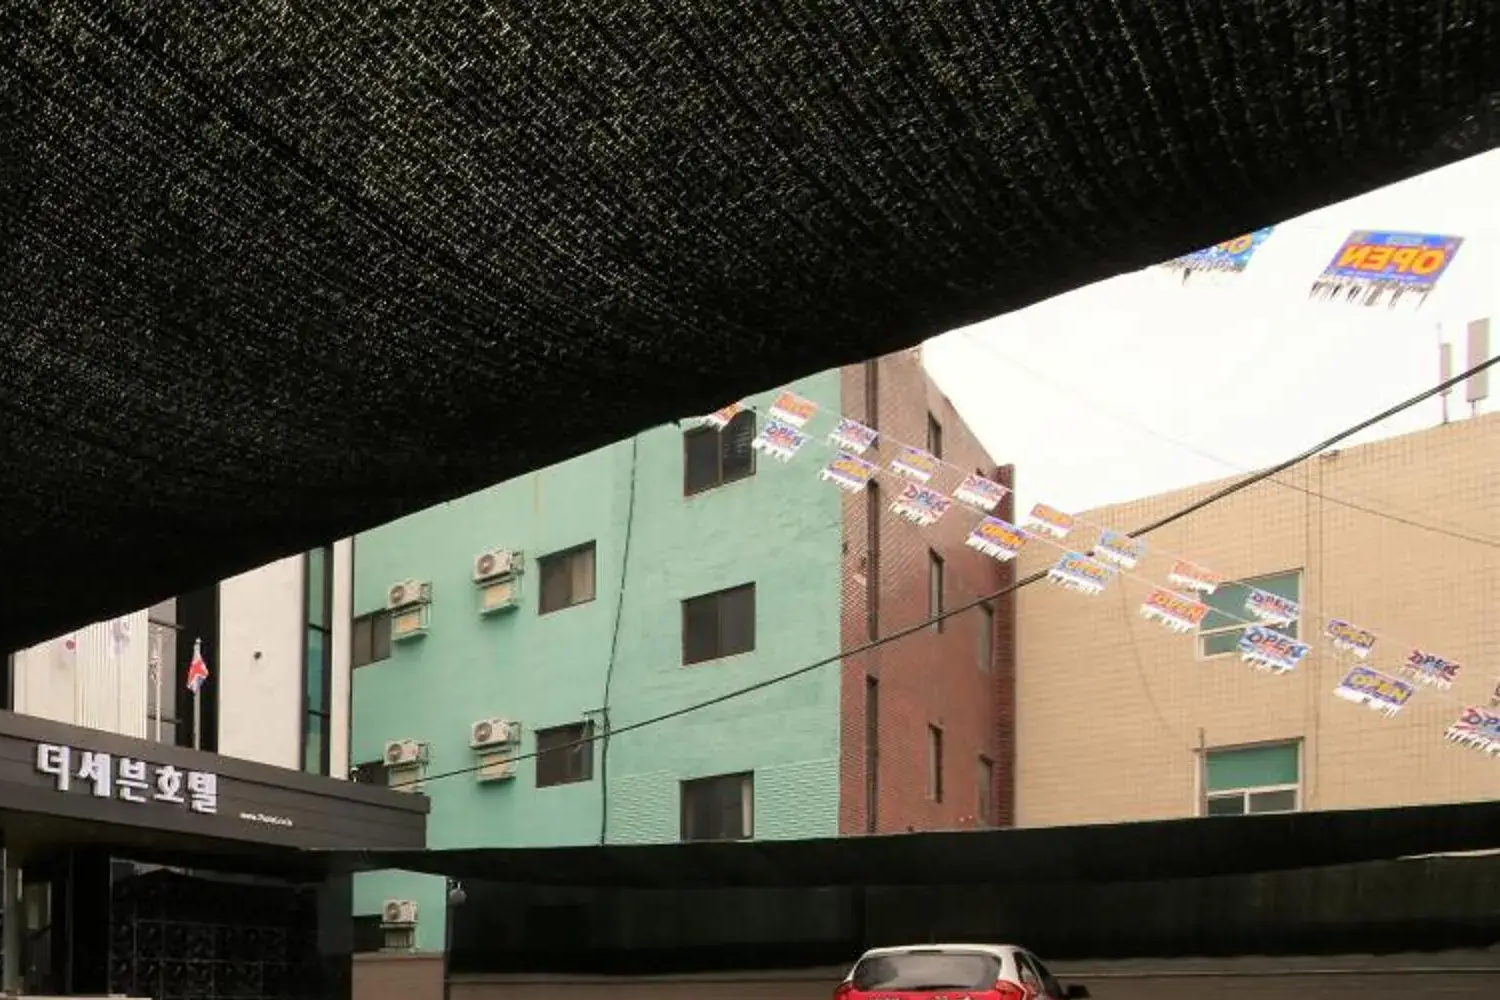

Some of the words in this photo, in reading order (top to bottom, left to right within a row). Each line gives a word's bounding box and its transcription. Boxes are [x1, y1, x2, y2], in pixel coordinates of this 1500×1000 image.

[1154, 593, 1207, 625] OPEN
[1248, 630, 1305, 660] OPEN
[1352, 673, 1407, 703] OPEN
[37, 742, 218, 814] 더세븐호텔
